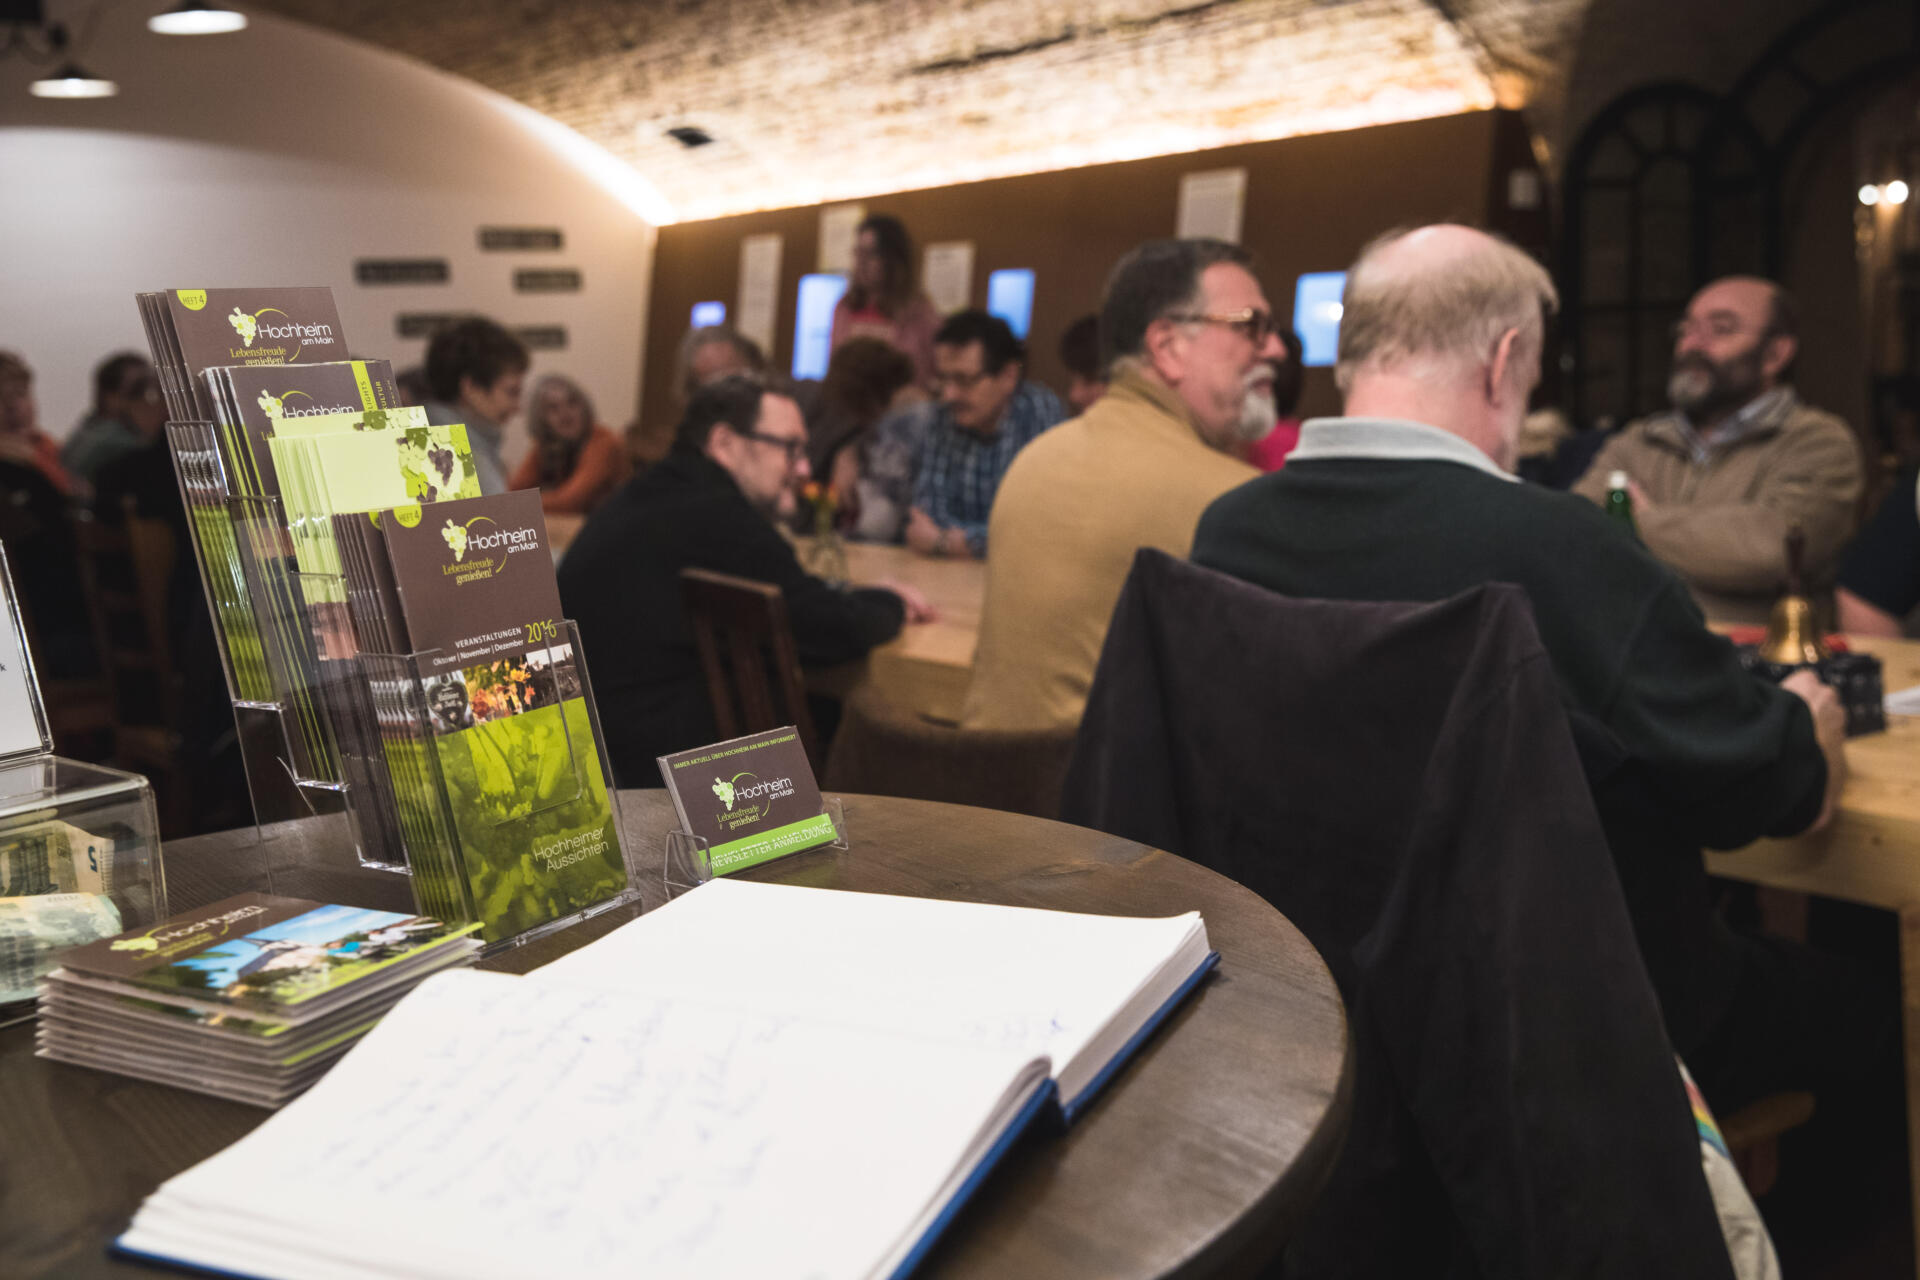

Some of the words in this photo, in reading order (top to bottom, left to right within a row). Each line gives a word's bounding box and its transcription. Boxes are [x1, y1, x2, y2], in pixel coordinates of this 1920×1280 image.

[199, 295, 205, 305] 4
[257, 322, 332, 339] Hochheim
[301, 338, 314, 346] am
[314, 337, 335, 345] Main
[230, 346, 286, 359] Lebensfreude
[284, 404, 354, 419] Hochheim
[414, 509, 420, 521] 4
[468, 527, 537, 551] Hochheim
[507, 544, 519, 554] am
[519, 541, 539, 552] Main
[442, 557, 494, 575] Lebensfreude
[456, 568, 493, 586] genießen!
[455, 627, 522, 649] VERANSTALTUNGEN
[461, 647, 492, 660] November
[495, 639, 525, 653] Dezember
[724, 745, 750, 757] HOCHHEIM
[734, 777, 793, 801] Hochheim
[769, 790, 780, 800] am
[780, 788, 795, 798] Main
[716, 804, 760, 823] Lebensfreude
[533, 827, 605, 862] Hochheimer
[711, 841, 772, 869] NEWSLETTER
[773, 822, 833, 850] ANMELDUNG
[546, 841, 610, 873] Aussichten
